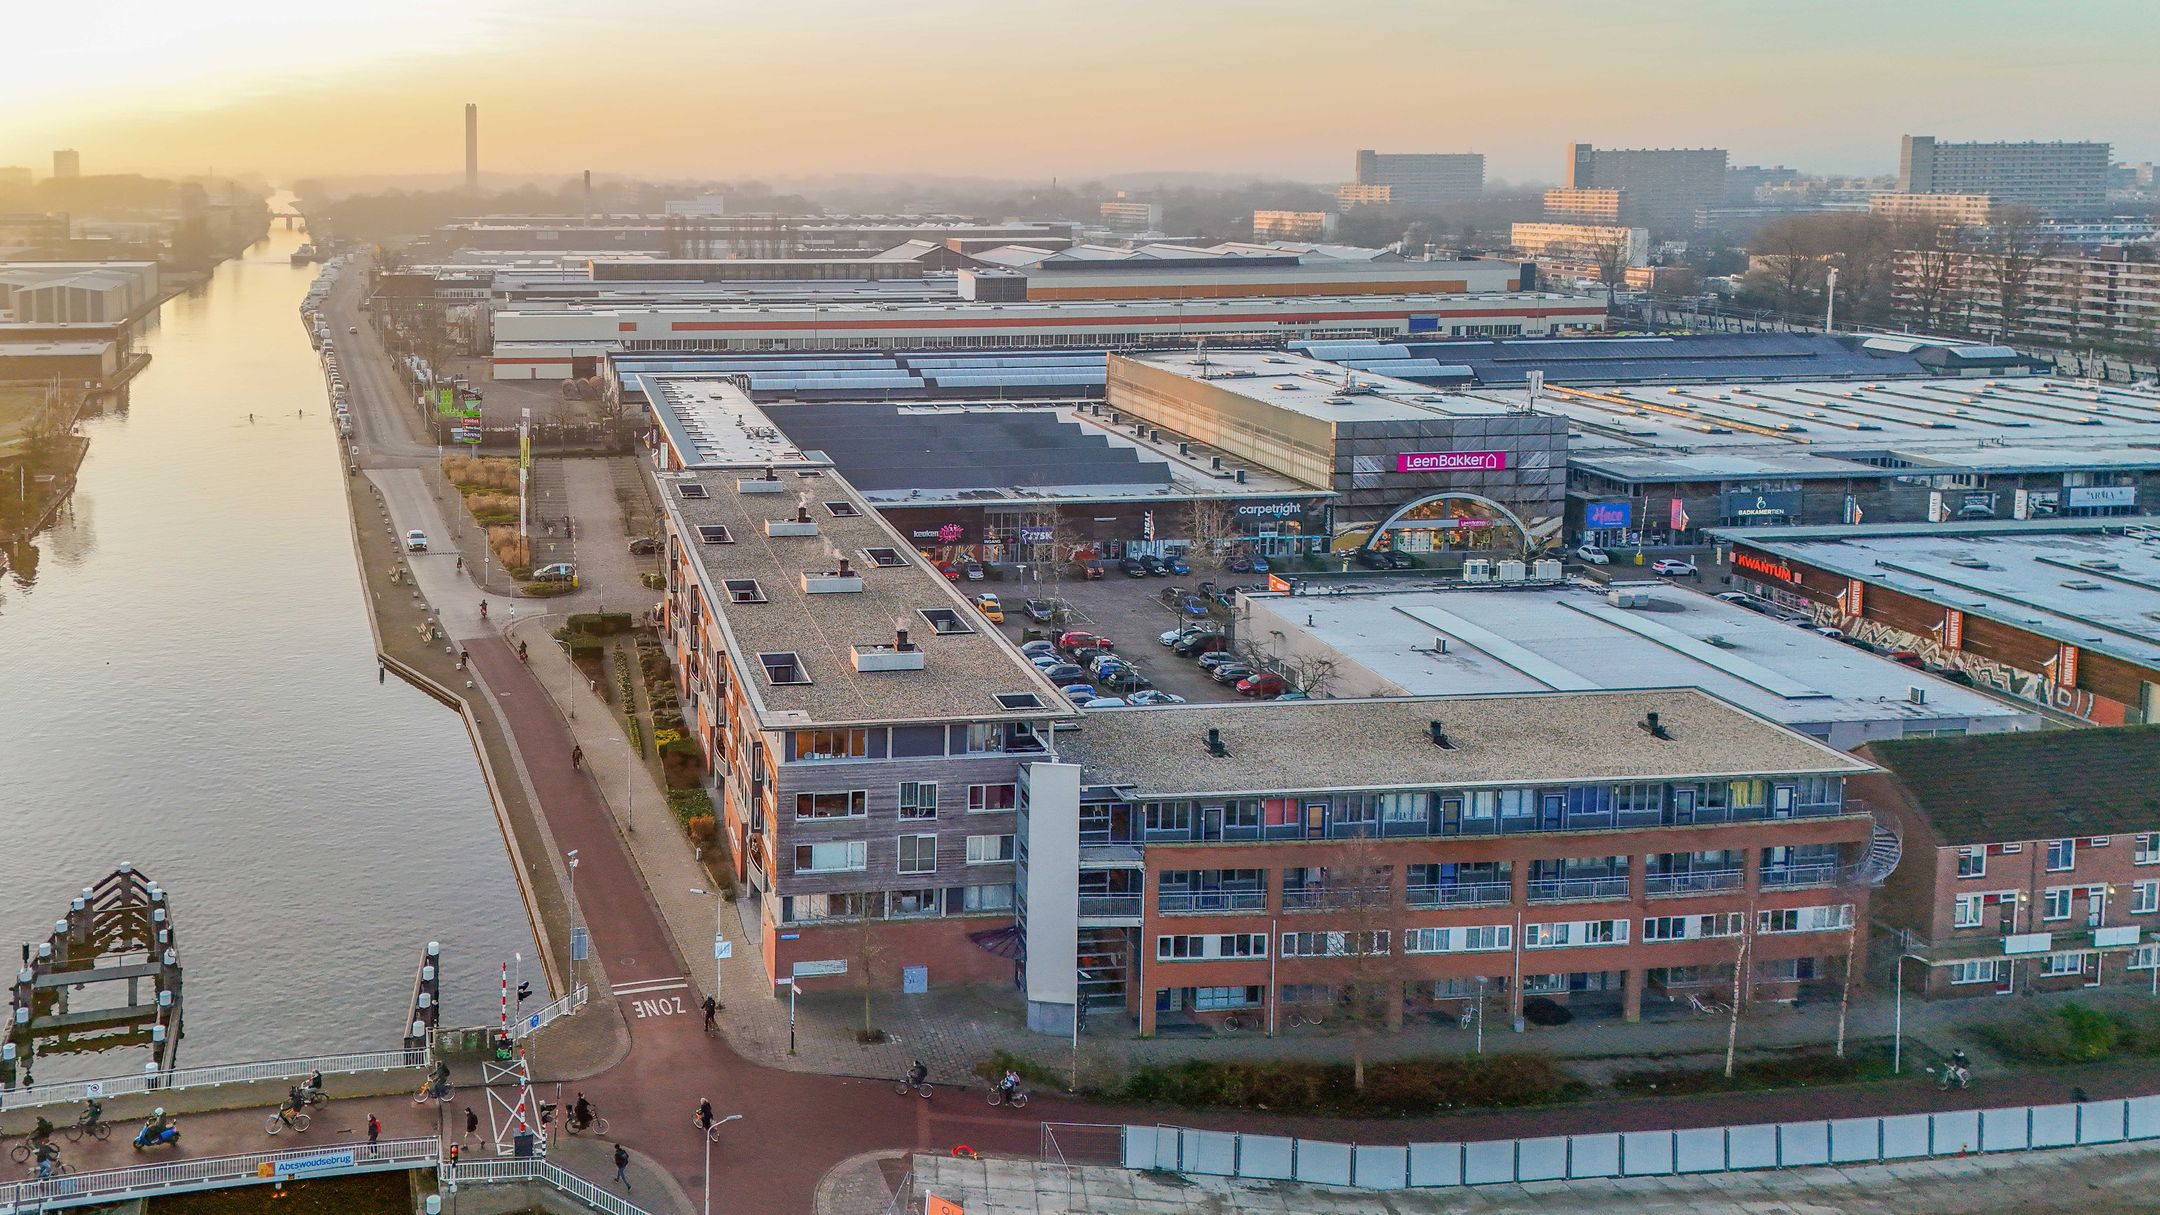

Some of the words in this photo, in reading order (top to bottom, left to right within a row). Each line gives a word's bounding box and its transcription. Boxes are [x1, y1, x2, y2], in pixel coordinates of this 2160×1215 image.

[1407, 454, 1485, 468] LeenBakker
[1239, 502, 1301, 517] carpetright
[914, 530, 939, 538] keuken
[1028, 531, 1054, 540] JYSK
[1738, 555, 1791, 580] KWANTUM
[1851, 580, 1861, 615] KWANTUM
[1949, 611, 1960, 647] KWANTUM
[2063, 646, 2073, 686] KWANTUM
[632, 997, 687, 1018] ZONE
[278, 1155, 351, 1172] Abtswoudsebrug
